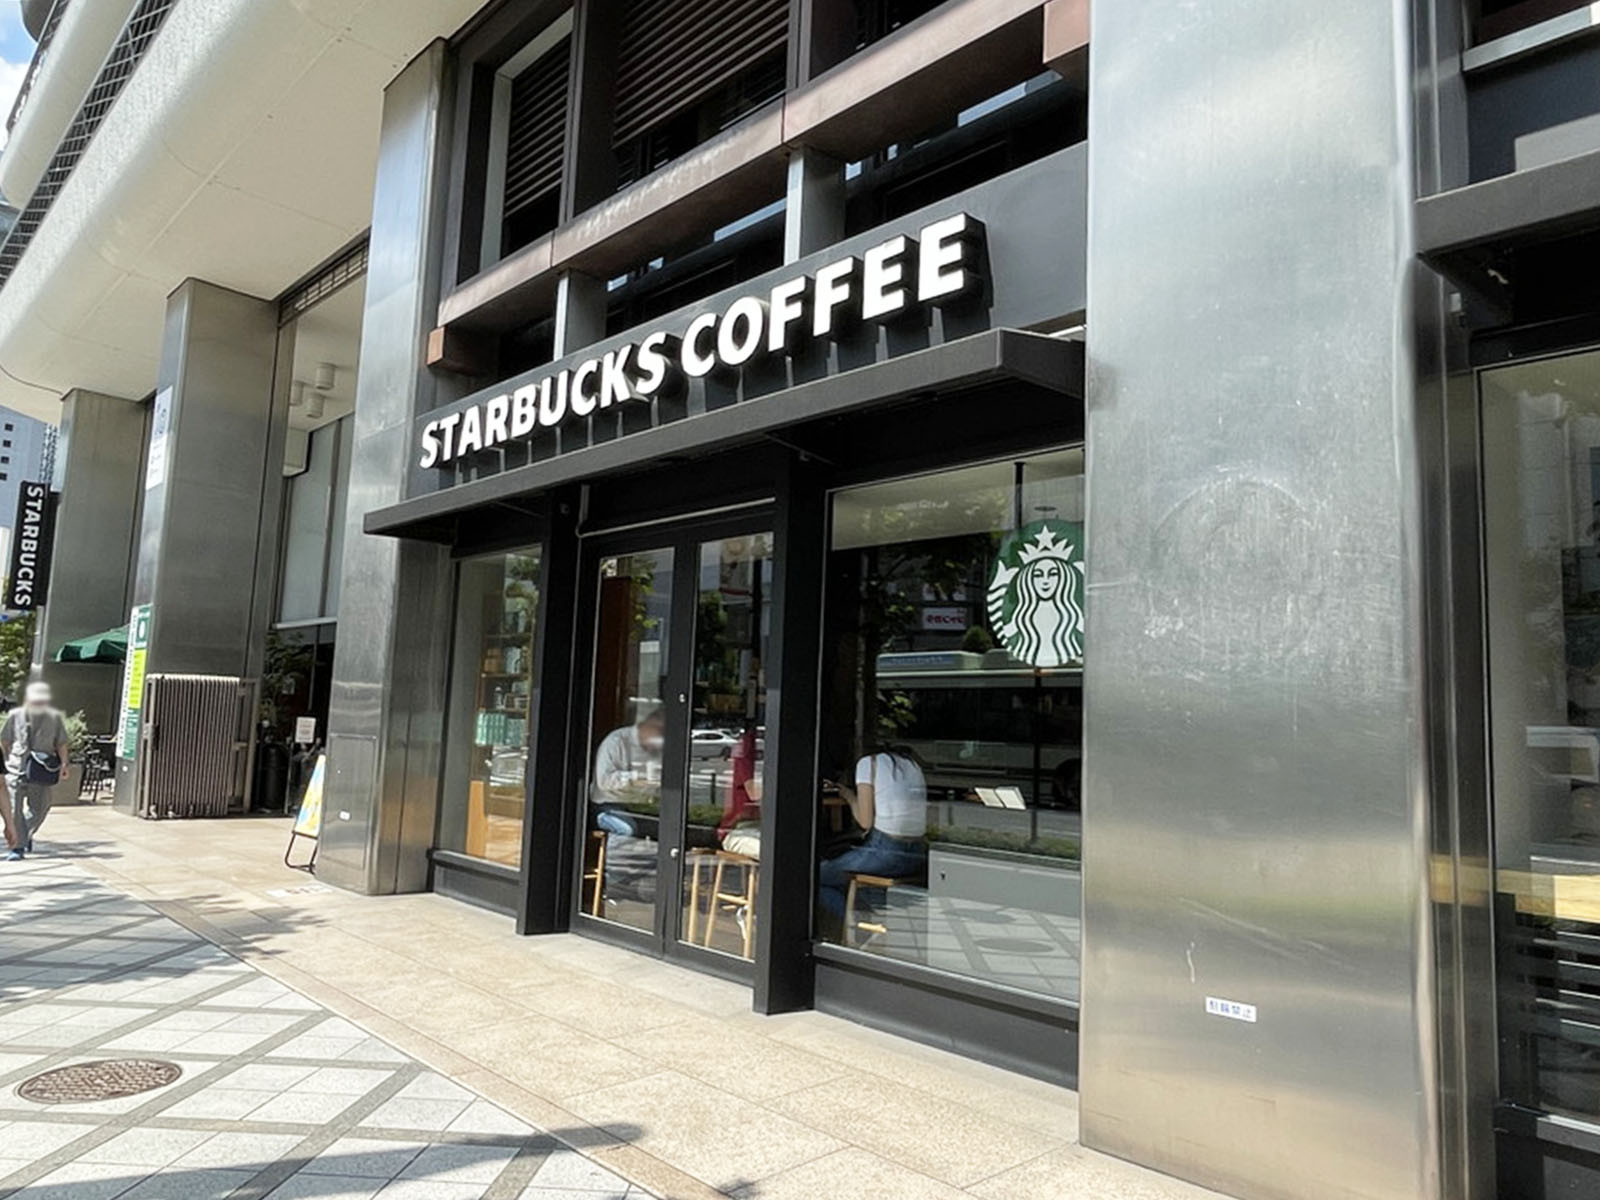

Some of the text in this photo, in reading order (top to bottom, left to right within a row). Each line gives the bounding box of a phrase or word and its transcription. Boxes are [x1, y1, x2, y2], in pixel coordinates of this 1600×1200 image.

[419, 212, 967, 469] STARBUCKS COFFEE
[14, 486, 44, 606] STARBUCKS
